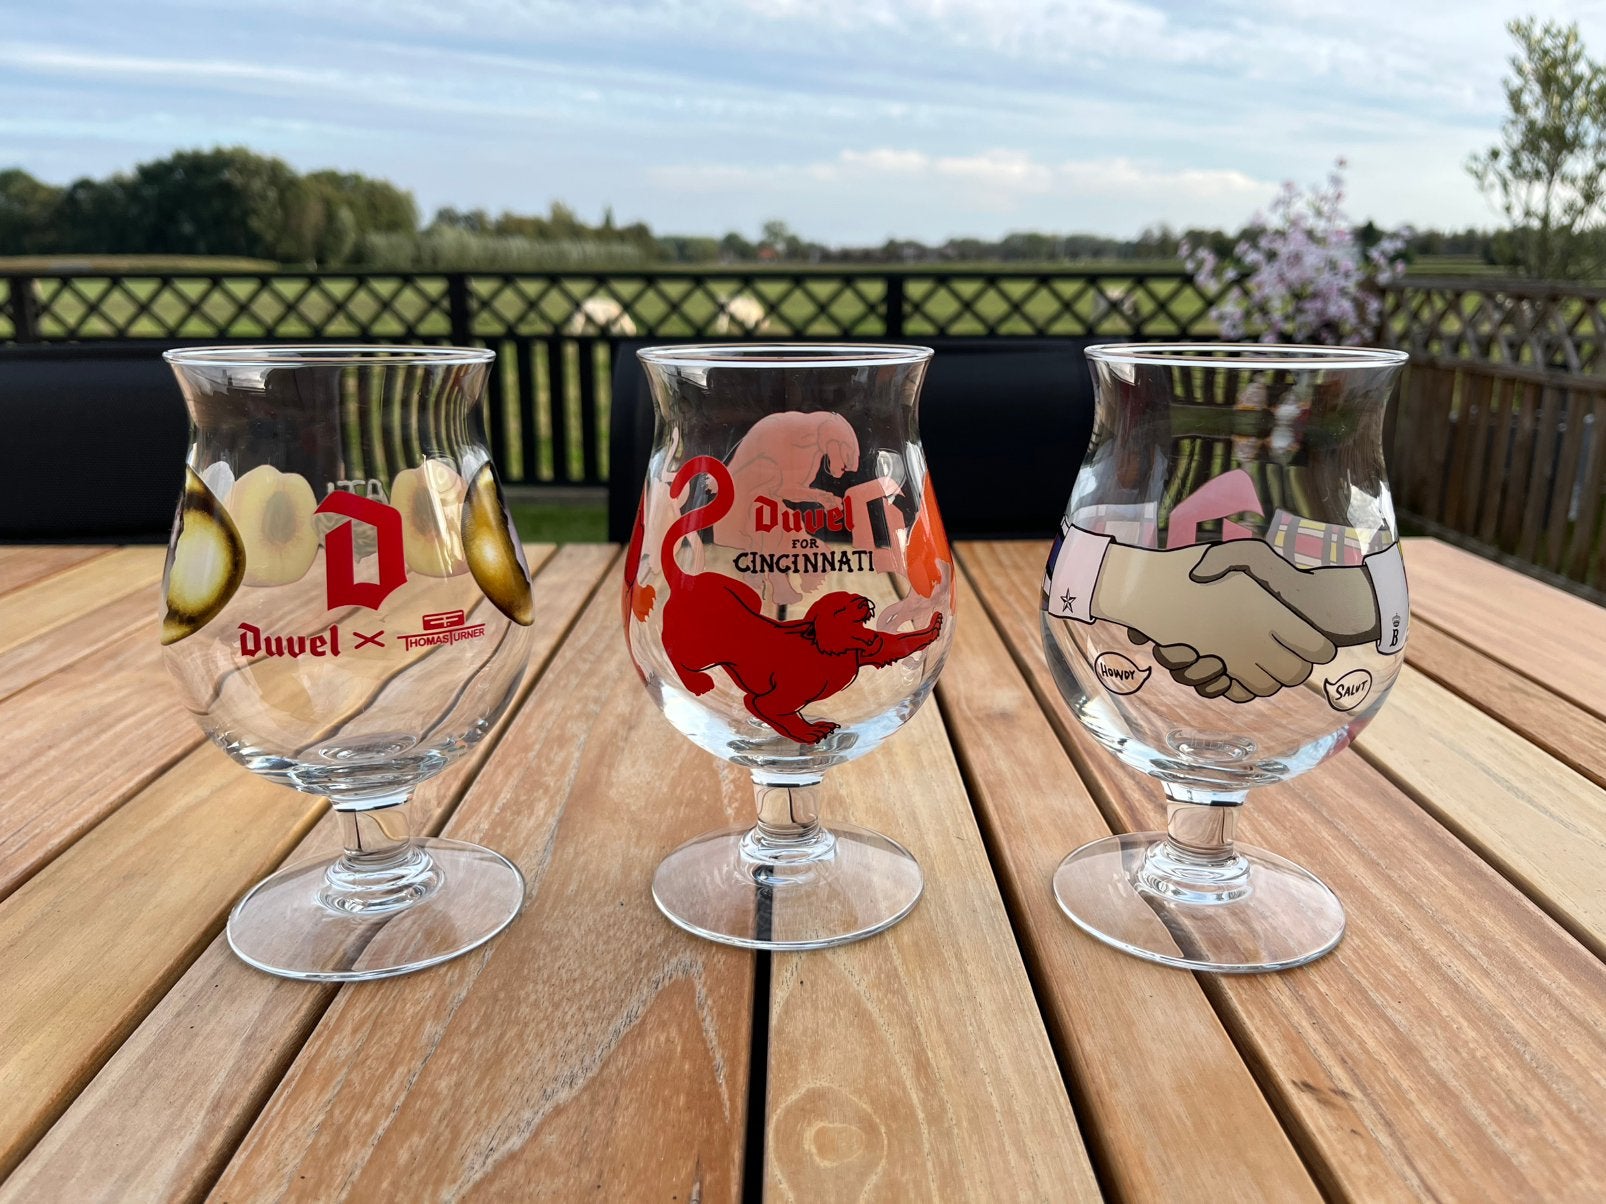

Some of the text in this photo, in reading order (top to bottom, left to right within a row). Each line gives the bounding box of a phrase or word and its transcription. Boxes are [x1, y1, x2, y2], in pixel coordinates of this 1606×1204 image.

[753, 495, 855, 534] Duvel
[313, 489, 408, 611] D
[791, 538, 819, 549] FOR
[732, 550, 875, 574] CINCINNATI
[237, 622, 341, 658] Duvel
[1100, 661, 1136, 681] HOWDY
